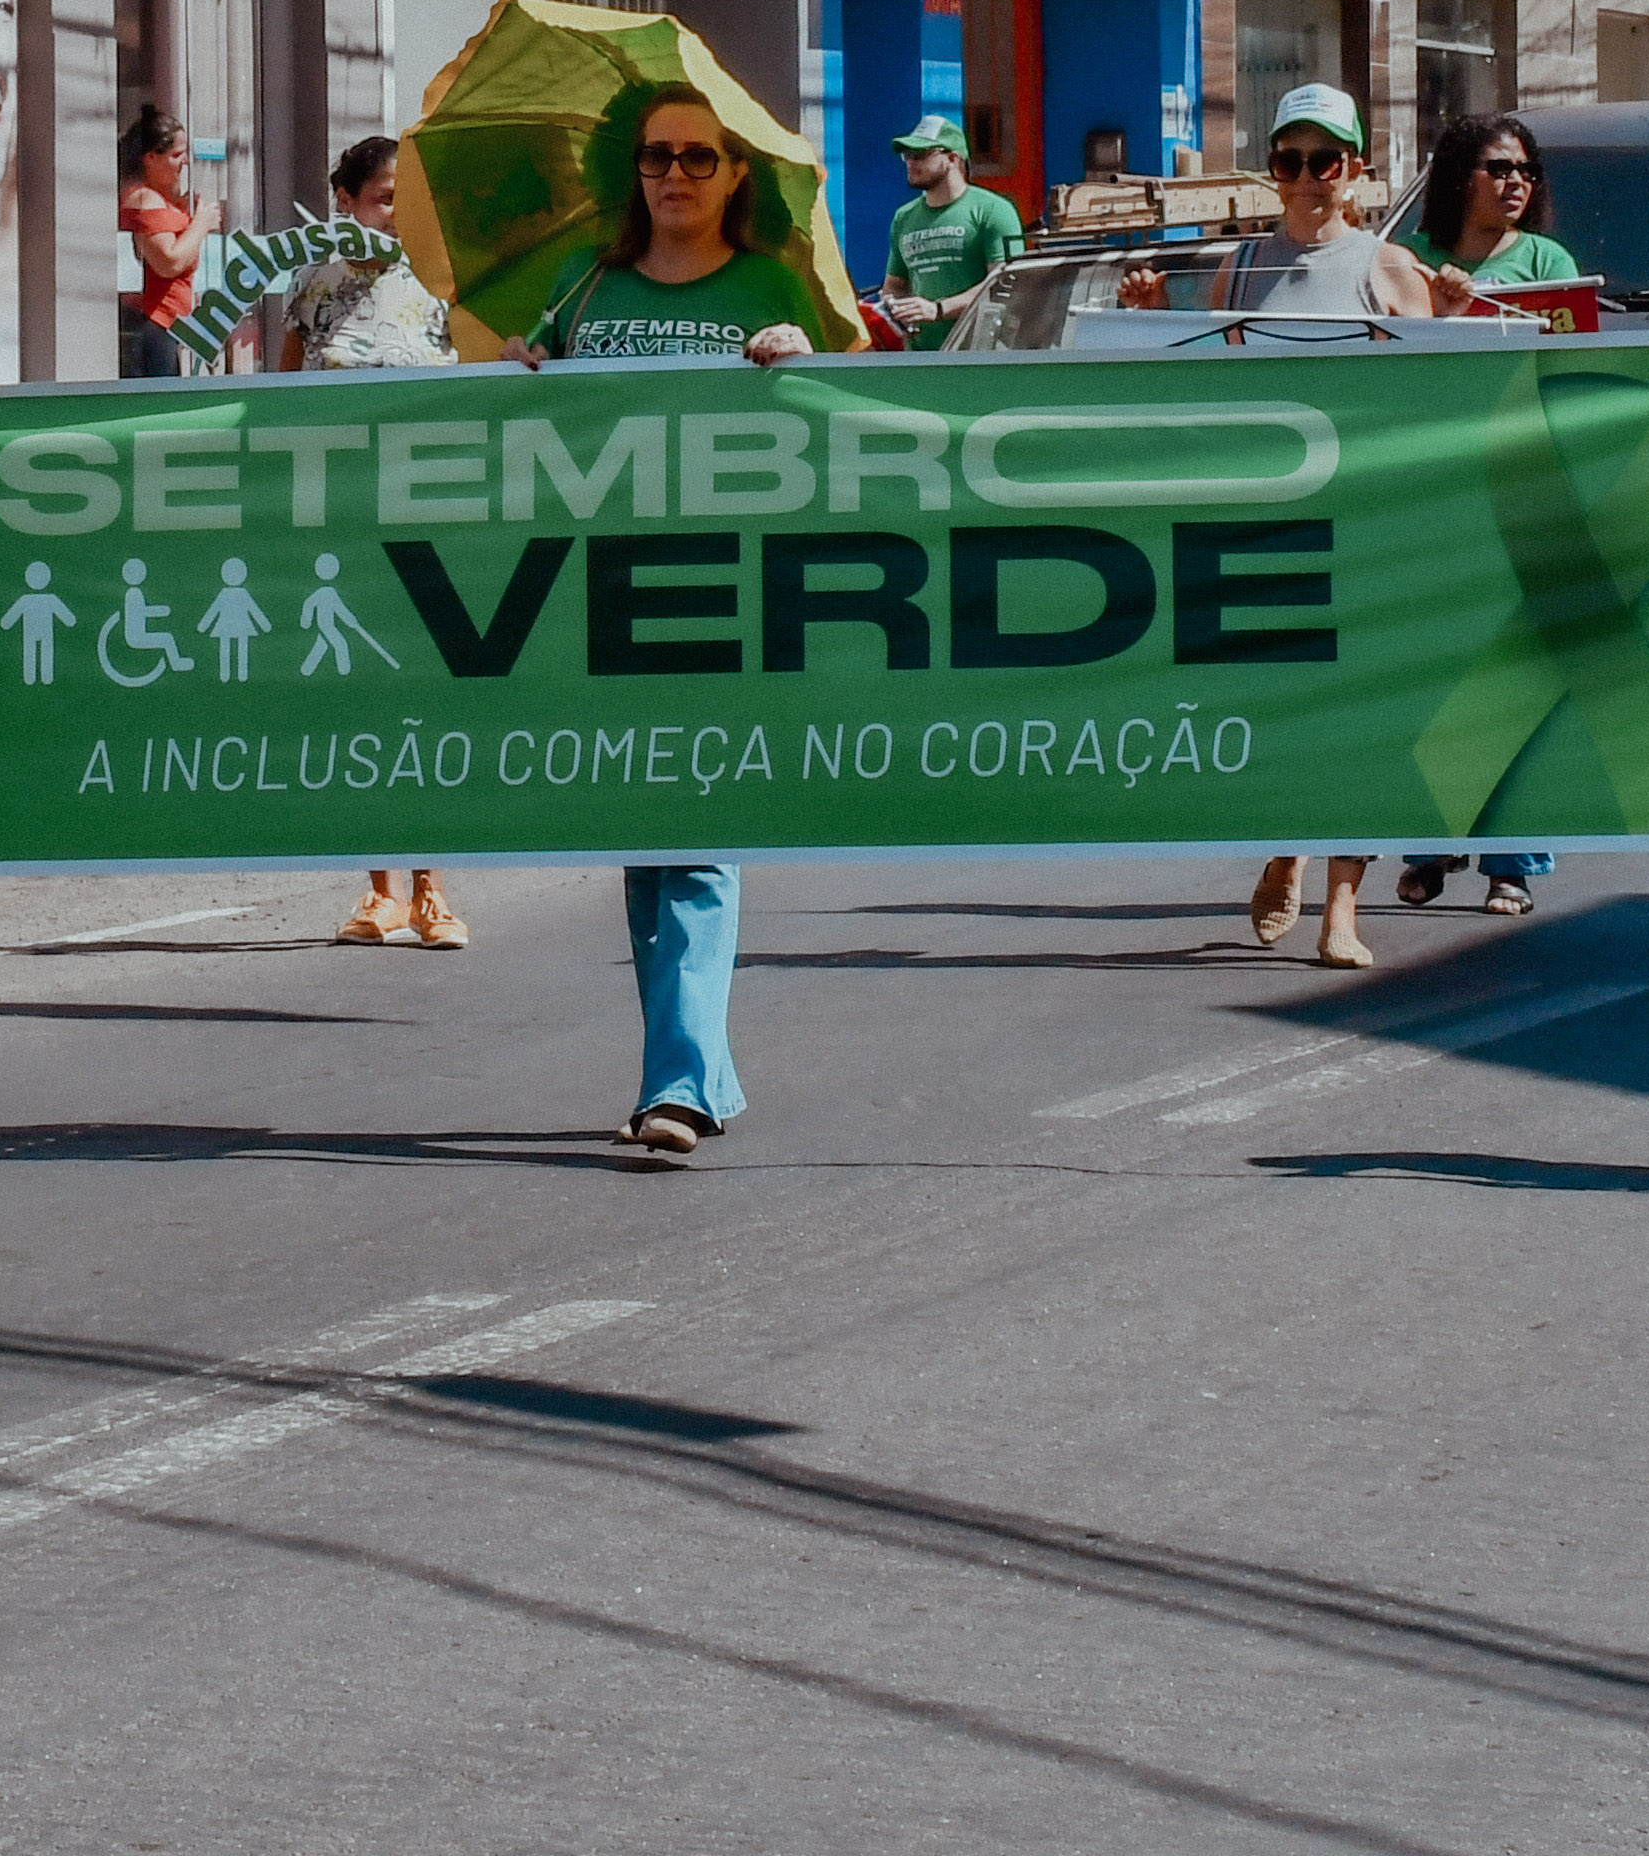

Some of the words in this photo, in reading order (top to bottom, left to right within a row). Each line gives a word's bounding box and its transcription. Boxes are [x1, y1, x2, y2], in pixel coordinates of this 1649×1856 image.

[578, 319, 745, 342] SETEMBRO
[383, 518, 1338, 677] VERDE
[78, 742, 115, 795] A
[142, 718, 472, 793] INCLUSÃO
[497, 723, 775, 795] COMEÇA
[801, 721, 894, 780] NO
[919, 702, 1253, 789] CORAÇÃO
